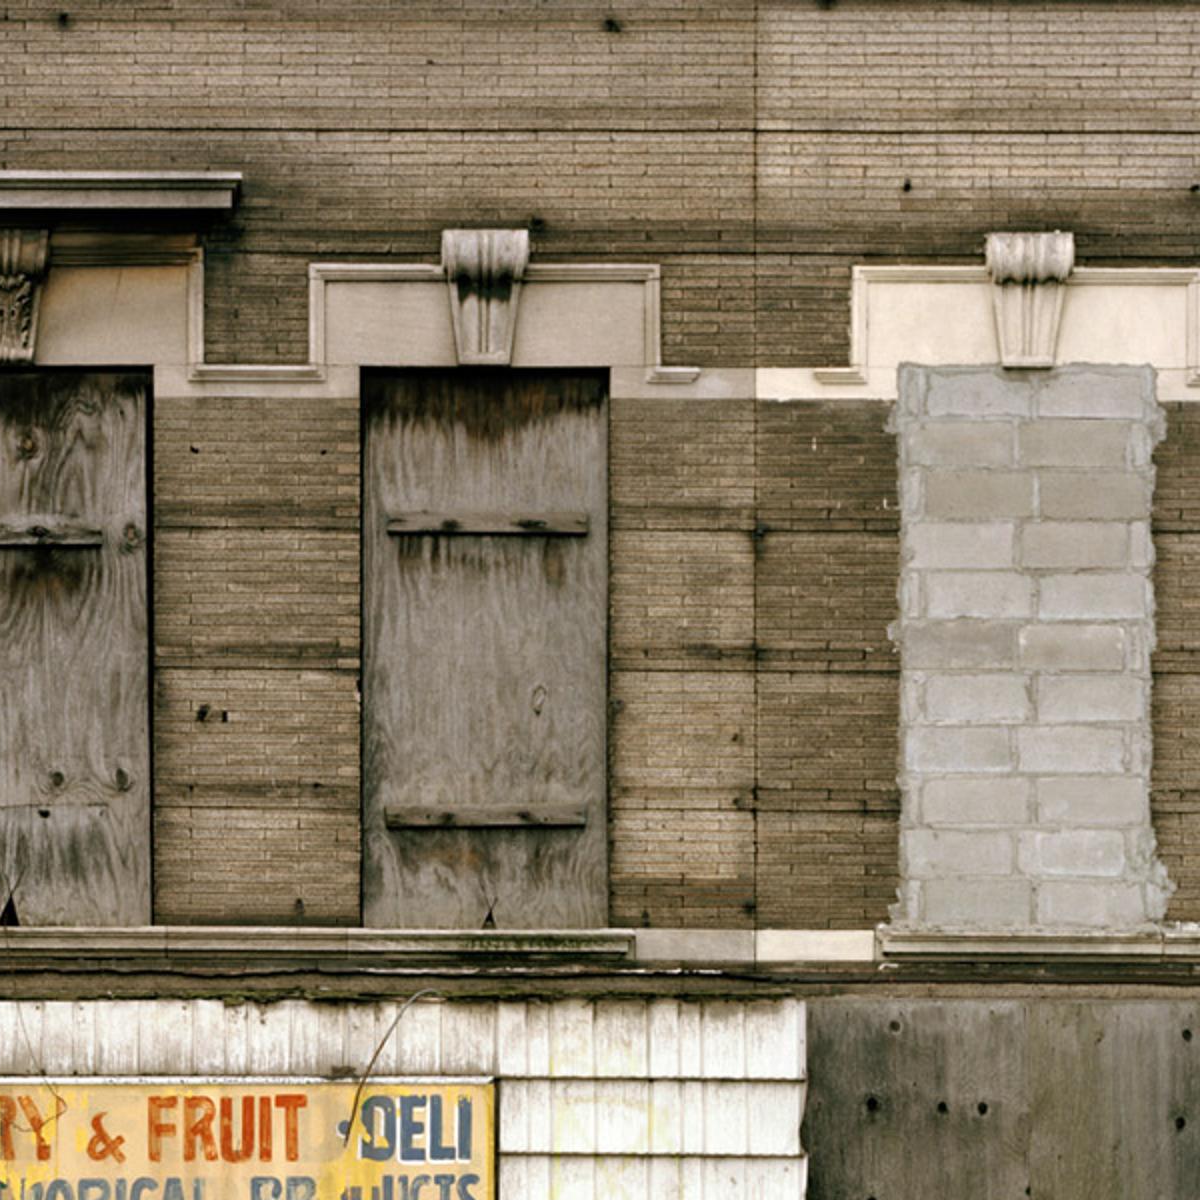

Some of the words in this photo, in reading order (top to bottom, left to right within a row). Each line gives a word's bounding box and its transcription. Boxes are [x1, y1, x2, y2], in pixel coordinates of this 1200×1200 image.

[86, 1111, 127, 1163] &
[148, 1094, 308, 1163] FRUIT
[360, 1093, 472, 1163] DELI
